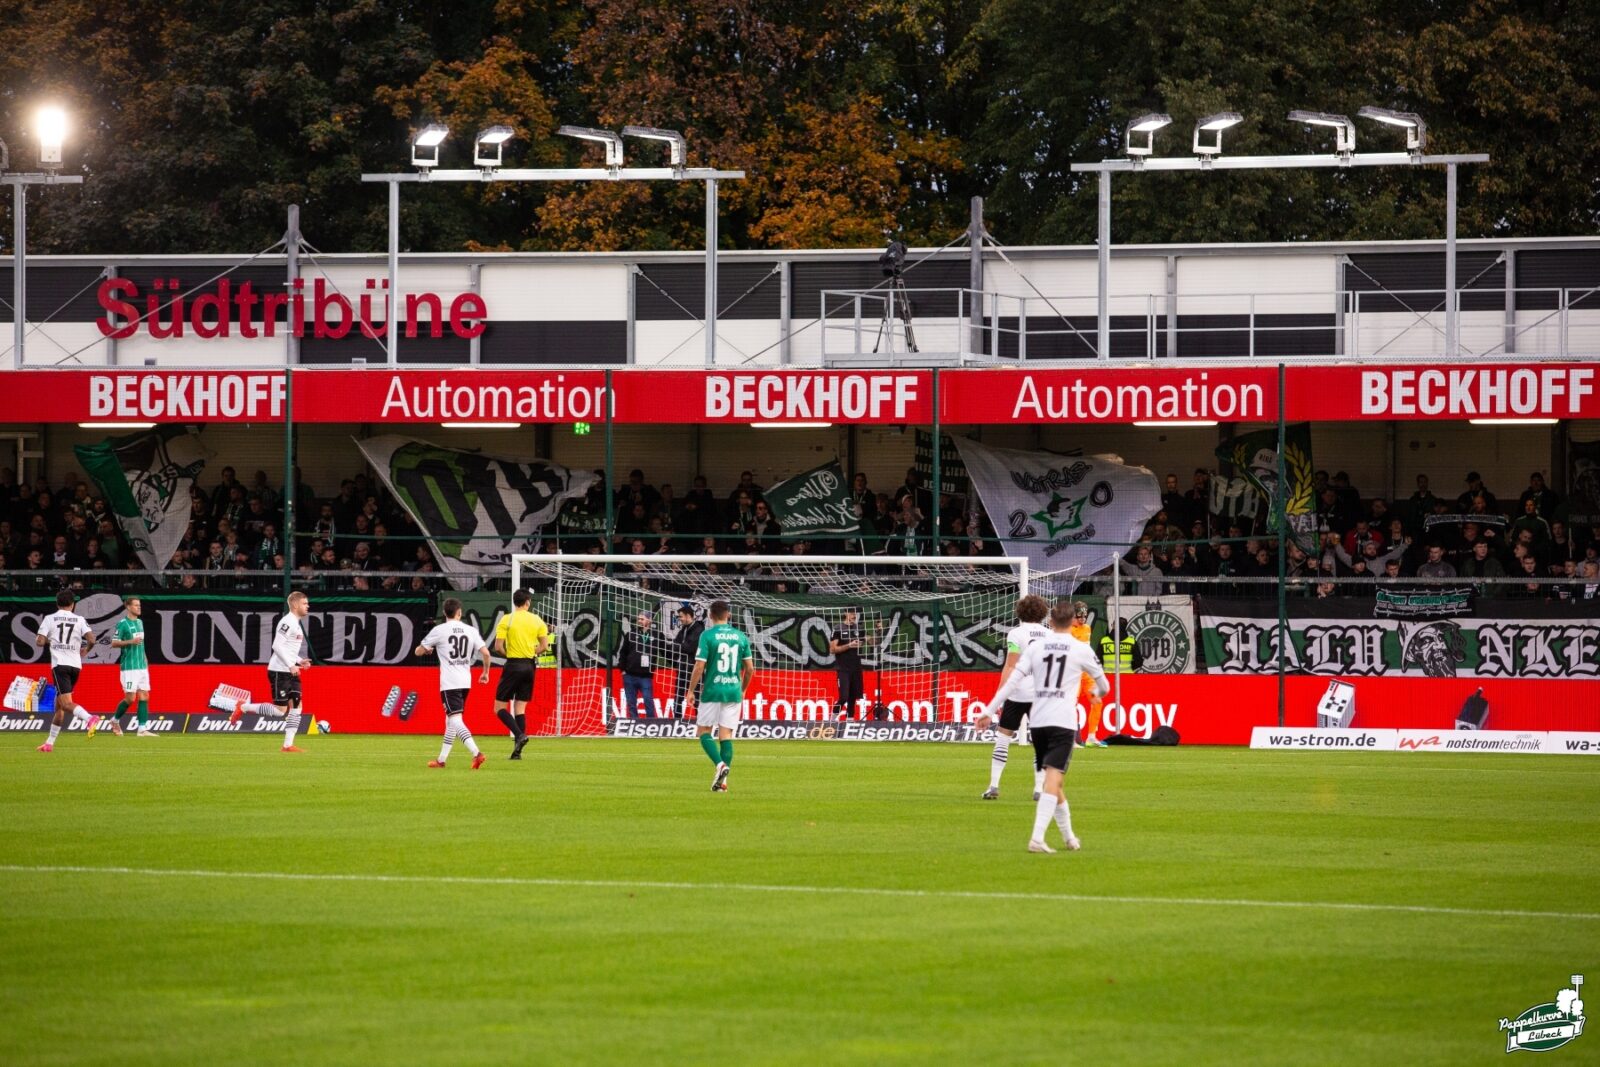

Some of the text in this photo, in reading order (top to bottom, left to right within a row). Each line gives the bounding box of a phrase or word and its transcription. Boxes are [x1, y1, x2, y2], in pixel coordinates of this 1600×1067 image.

[95, 278, 488, 340] Südtribüne
[89, 375, 286, 417] BECKHOFF
[381, 374, 616, 418] Automation
[705, 375, 918, 418] BECKHOFF
[1012, 373, 1264, 418] Automation
[1361, 369, 1595, 415] BECKHOFF
[57, 622, 75, 645] 17
[1127, 612, 1182, 637] UBKULTUR
[448, 634, 469, 659] 30
[717, 642, 739, 674] 31
[1043, 653, 1067, 689] 11
[0, 715, 44, 731] bwin
[843, 722, 957, 741] Eisenbach
[1269, 733, 1376, 747] wa-strom.de
[1446, 738, 1541, 751] notstromtechnik
